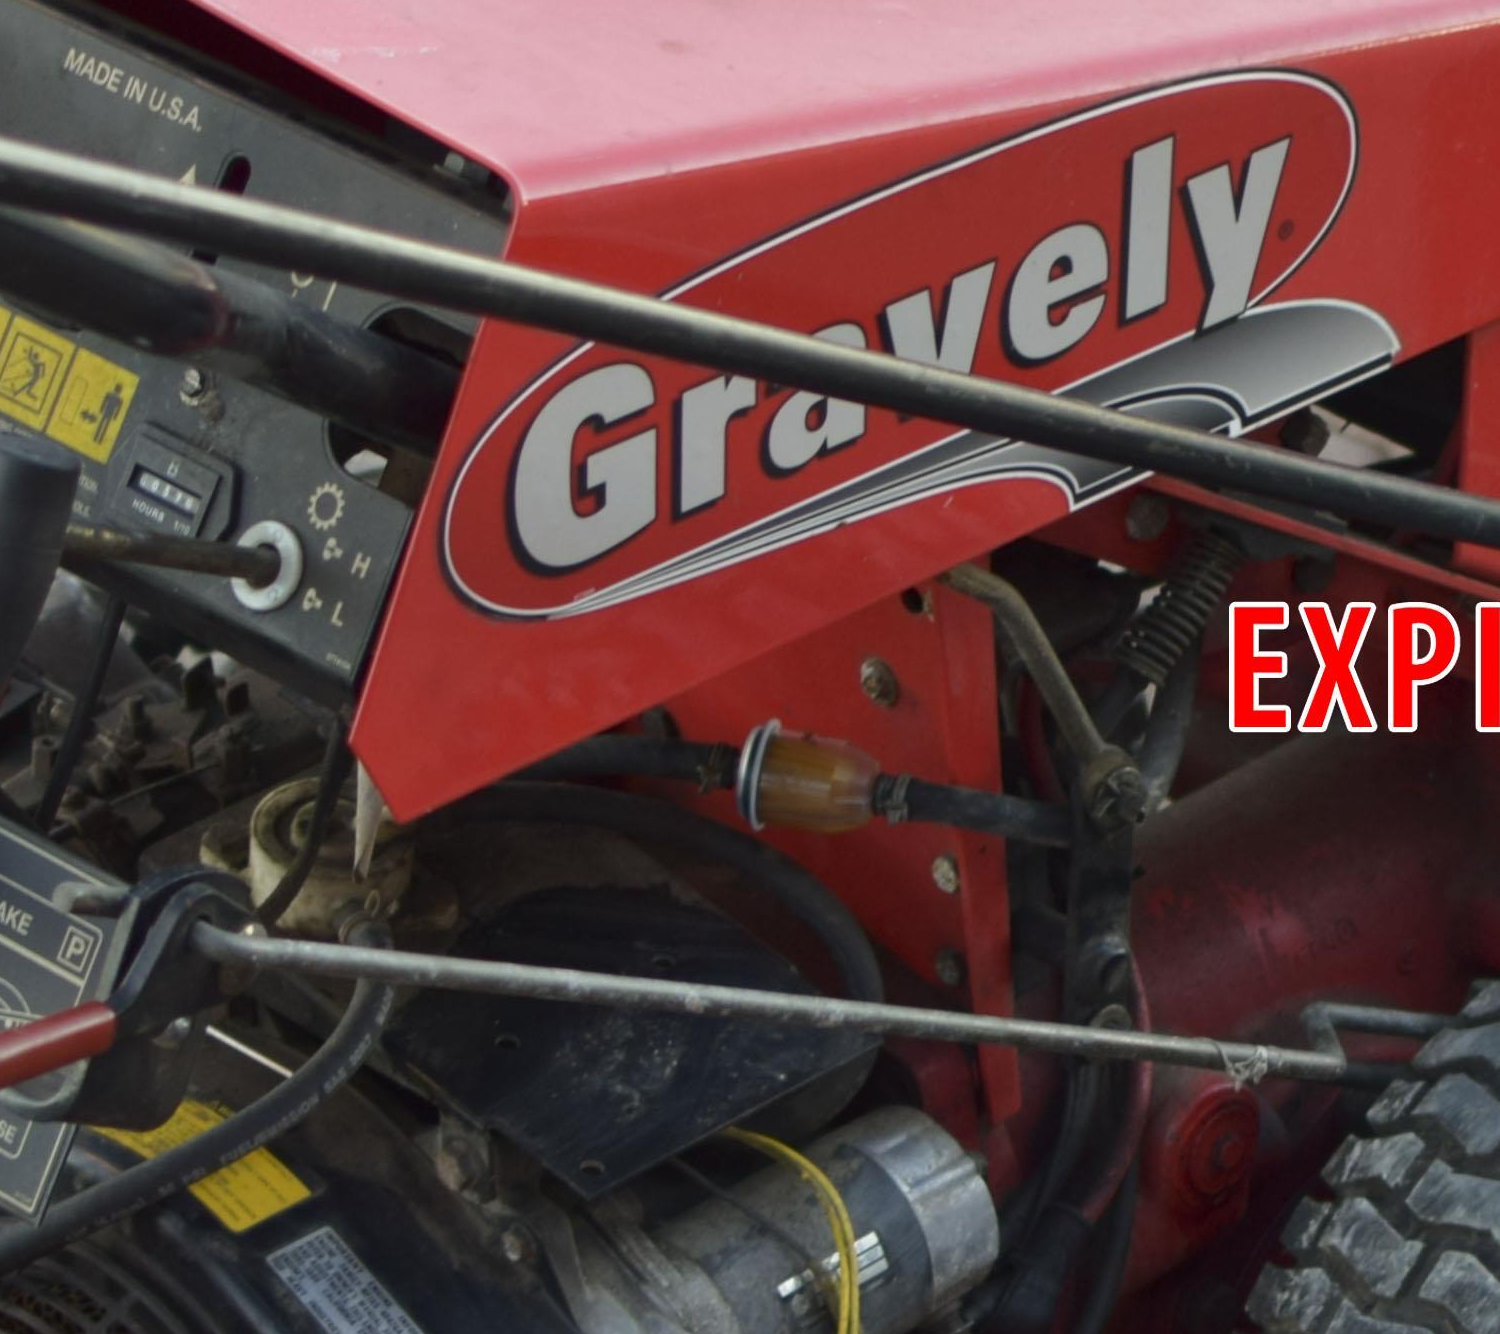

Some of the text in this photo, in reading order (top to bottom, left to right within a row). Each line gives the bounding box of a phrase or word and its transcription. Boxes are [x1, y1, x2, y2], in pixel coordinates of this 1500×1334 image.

[64, 47, 202, 132] MADE IN U.S.A.
[509, 134, 1291, 575] Gravely
[132, 498, 164, 523] HOURS
[351, 552, 371, 579] H
[331, 601, 343, 626] L
[66, 935, 85, 960] P
